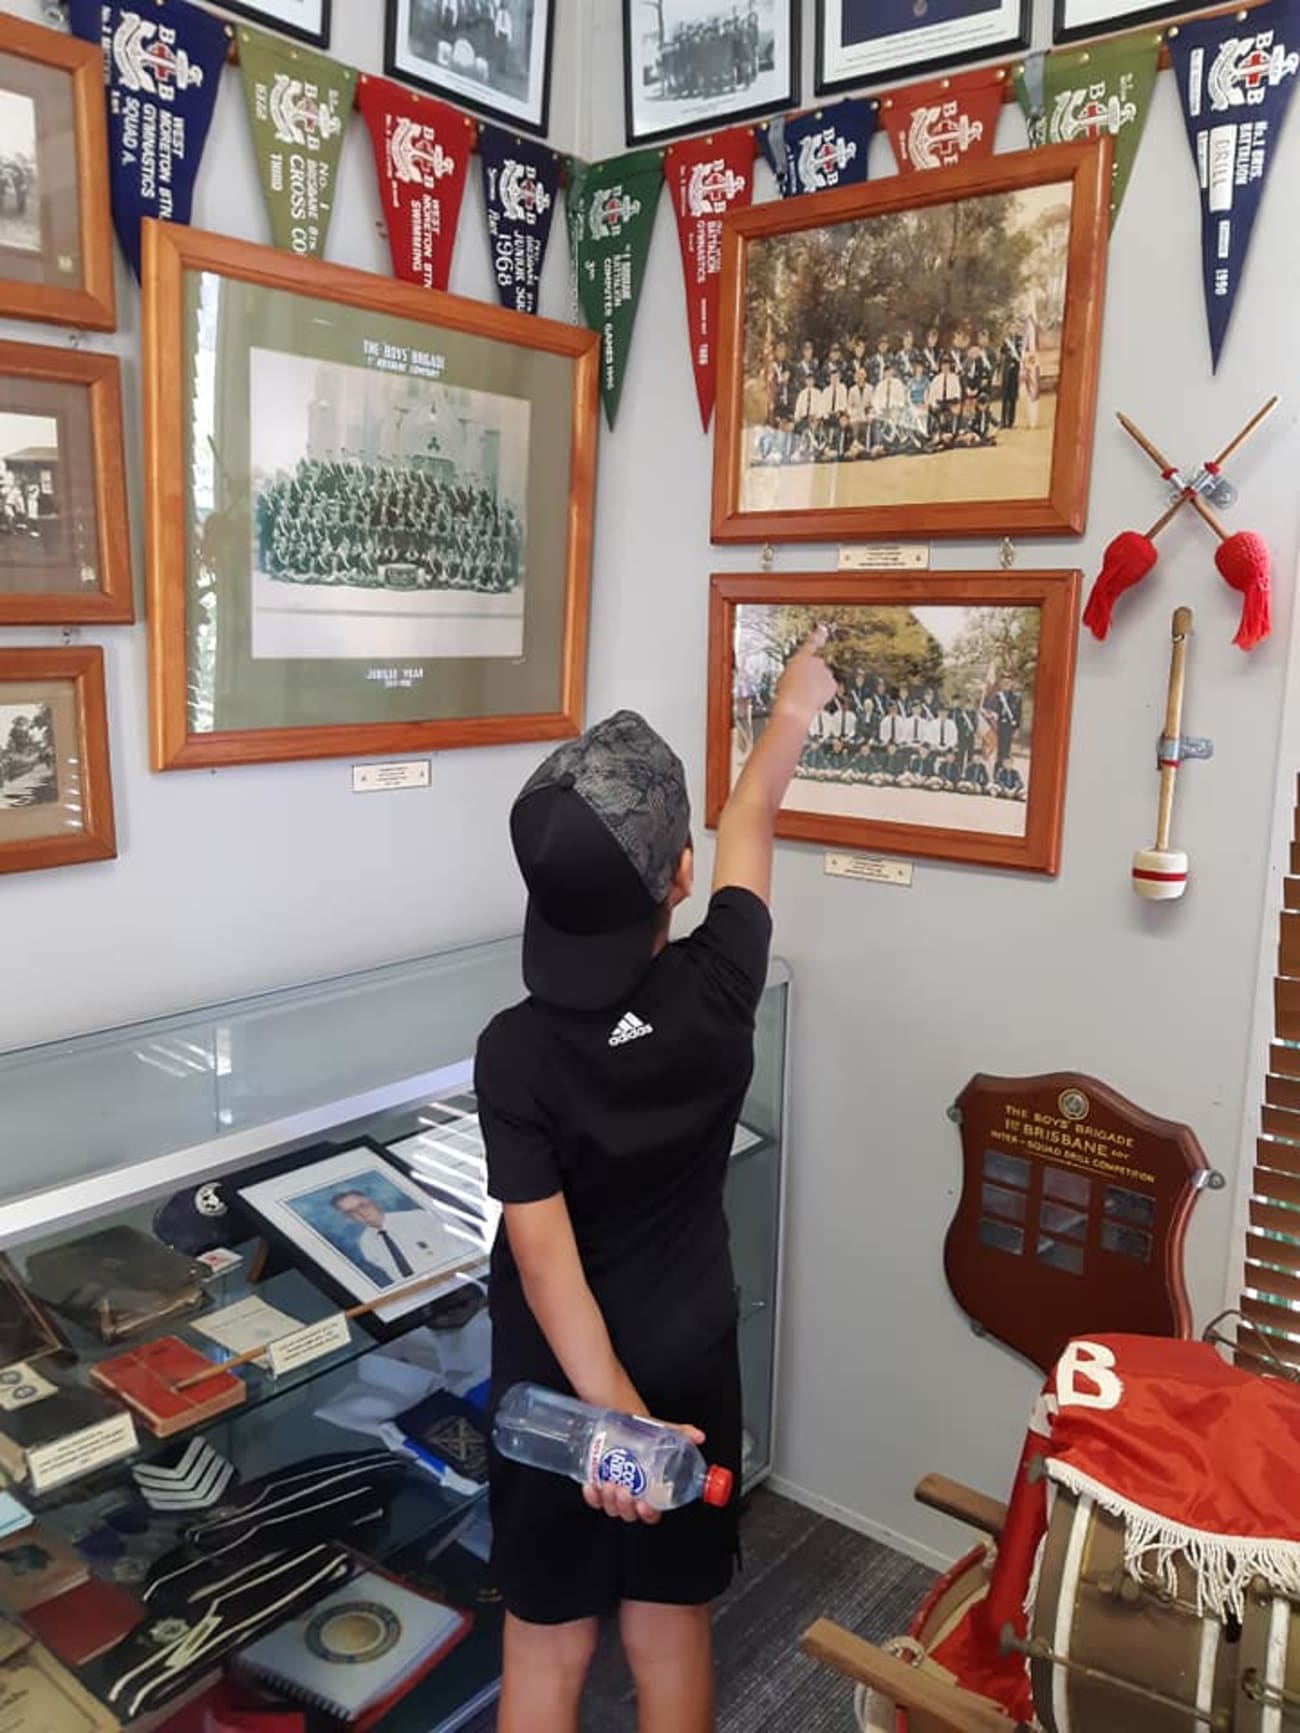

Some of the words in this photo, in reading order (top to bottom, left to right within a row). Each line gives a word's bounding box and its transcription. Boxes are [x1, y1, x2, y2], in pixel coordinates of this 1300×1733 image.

[159, 25, 175, 44] B
[1256, 29, 1274, 48] B
[159, 83, 174, 101] B
[304, 82, 318, 98] B
[1089, 81, 1106, 100] B
[1246, 86, 1265, 105] B
[124, 96, 139, 148] SQUAD
[943, 100, 958, 117] B
[159, 109, 172, 180] MORETON
[173, 117, 184, 158] WEST
[307, 135, 320, 151] B
[423, 126, 434, 140] B
[823, 126, 835, 140] B
[141, 103, 155, 198] GYMNASTICS
[1211, 139, 1228, 189] DRILL
[1236, 123, 1252, 186] BATTALION
[713, 159, 725, 171] B
[290, 154, 305, 219] CROSS
[423, 175, 434, 189] B
[714, 201, 726, 213] B
[411, 199, 421, 272] SWIMMING
[423, 194, 432, 258] MORETON
[291, 227, 307, 255] CO
[495, 233, 512, 286] 1968
[605, 323, 613, 364] GAMES
[608, 1024, 653, 1046] adidas
[1005, 1105, 1027, 1118] THE
[1075, 1124, 1136, 1148] BRIGADE
[1023, 1123, 1109, 1157] BRISBANE
[1056, 1341, 1124, 1409] B
